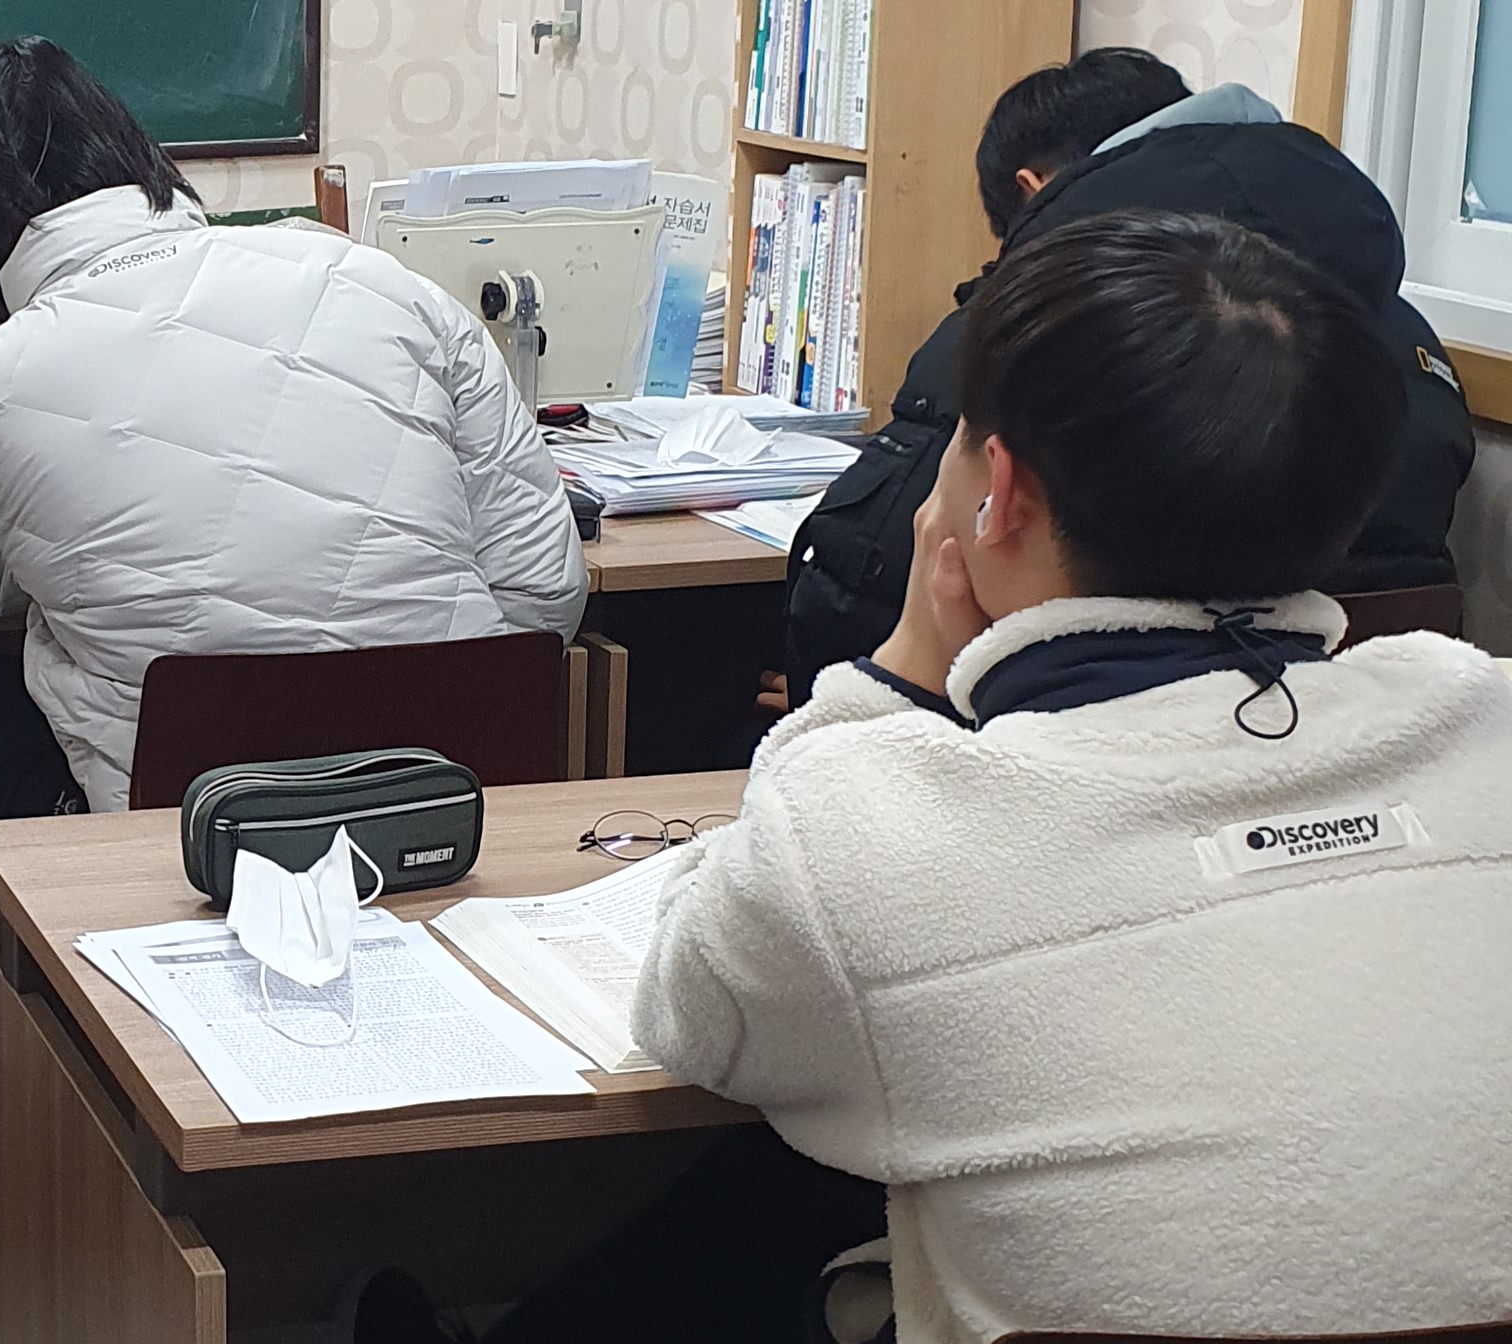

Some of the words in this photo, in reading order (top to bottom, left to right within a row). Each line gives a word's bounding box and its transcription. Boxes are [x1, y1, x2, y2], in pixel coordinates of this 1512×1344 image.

[664, 196, 711, 218] 자습서
[663, 214, 708, 235] 문제집
[416, 846, 455, 865] MOMENT
[1287, 833, 1371, 857] EXPEDITION
